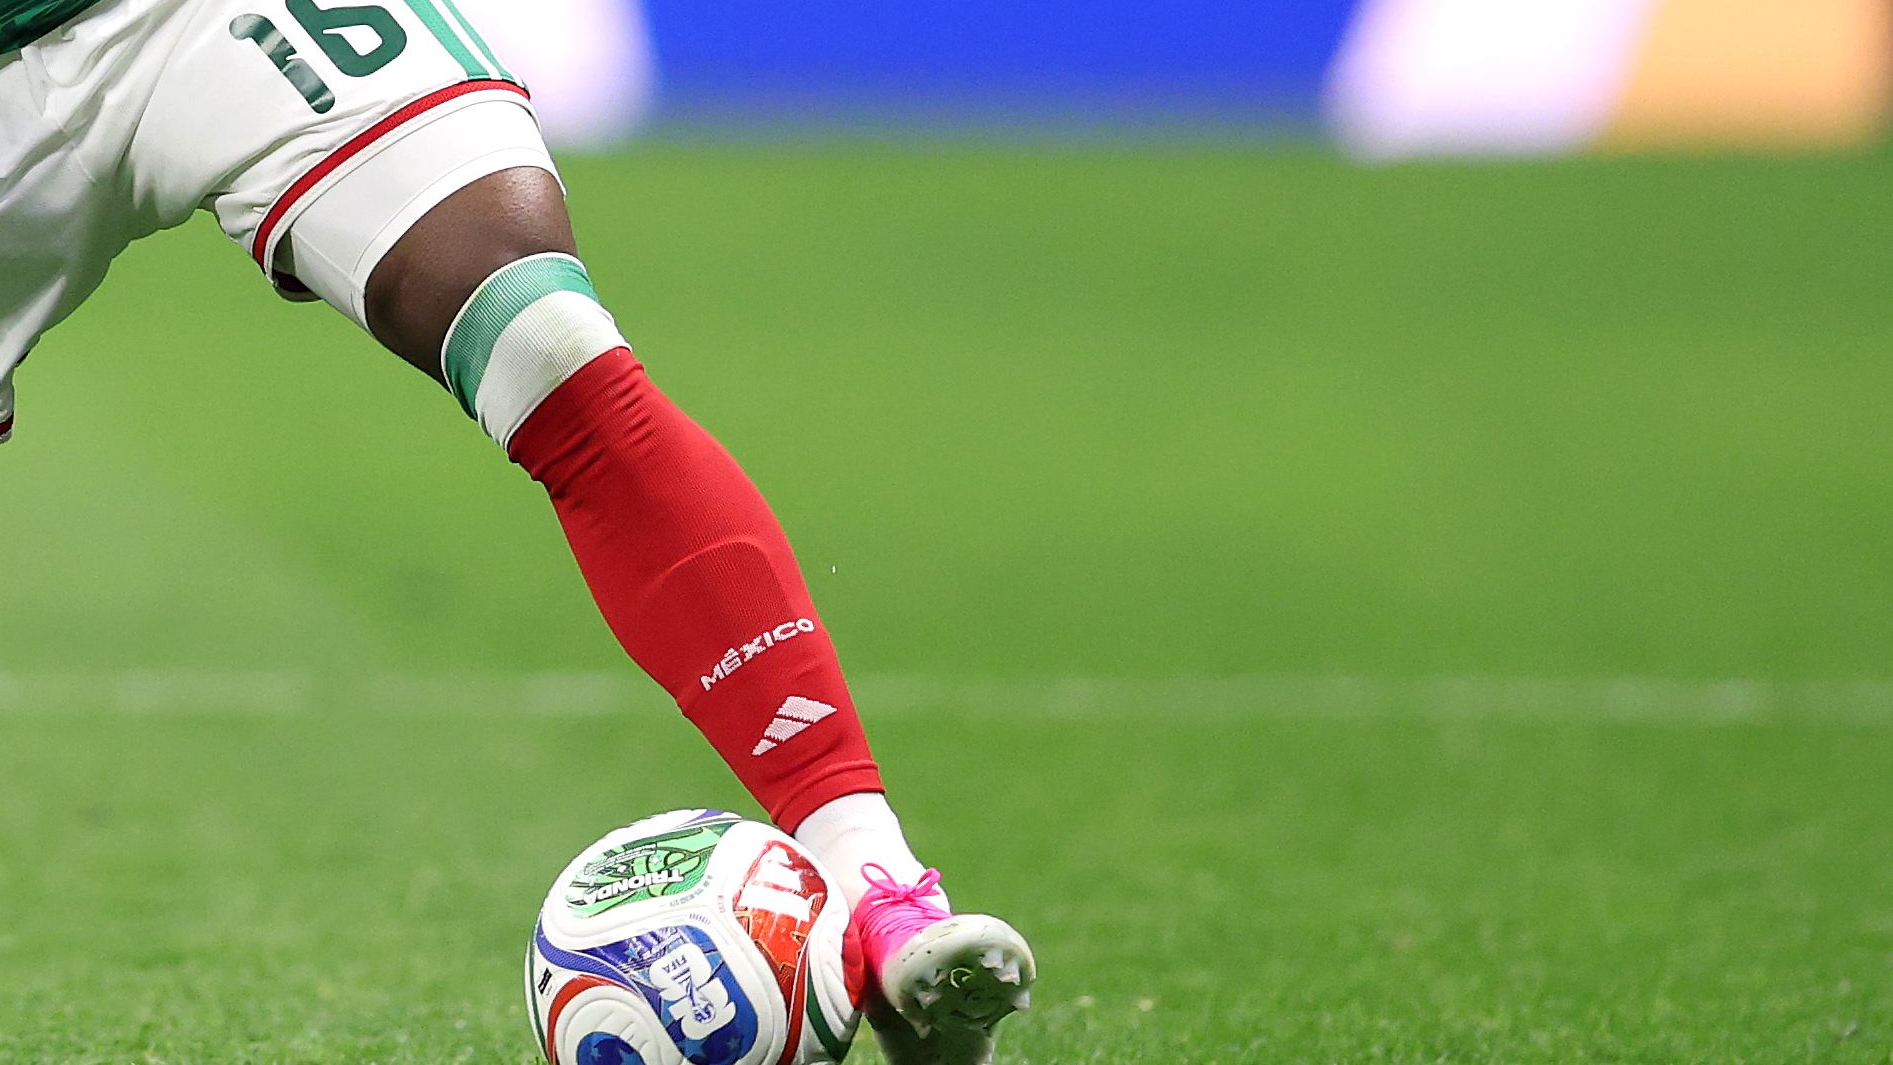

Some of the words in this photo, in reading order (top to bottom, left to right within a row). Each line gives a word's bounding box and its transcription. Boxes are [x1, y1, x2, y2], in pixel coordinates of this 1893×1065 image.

[700, 618, 815, 691] MÉXICO
[583, 868, 685, 905] TRIONDA
[661, 953, 687, 975] FIFA
